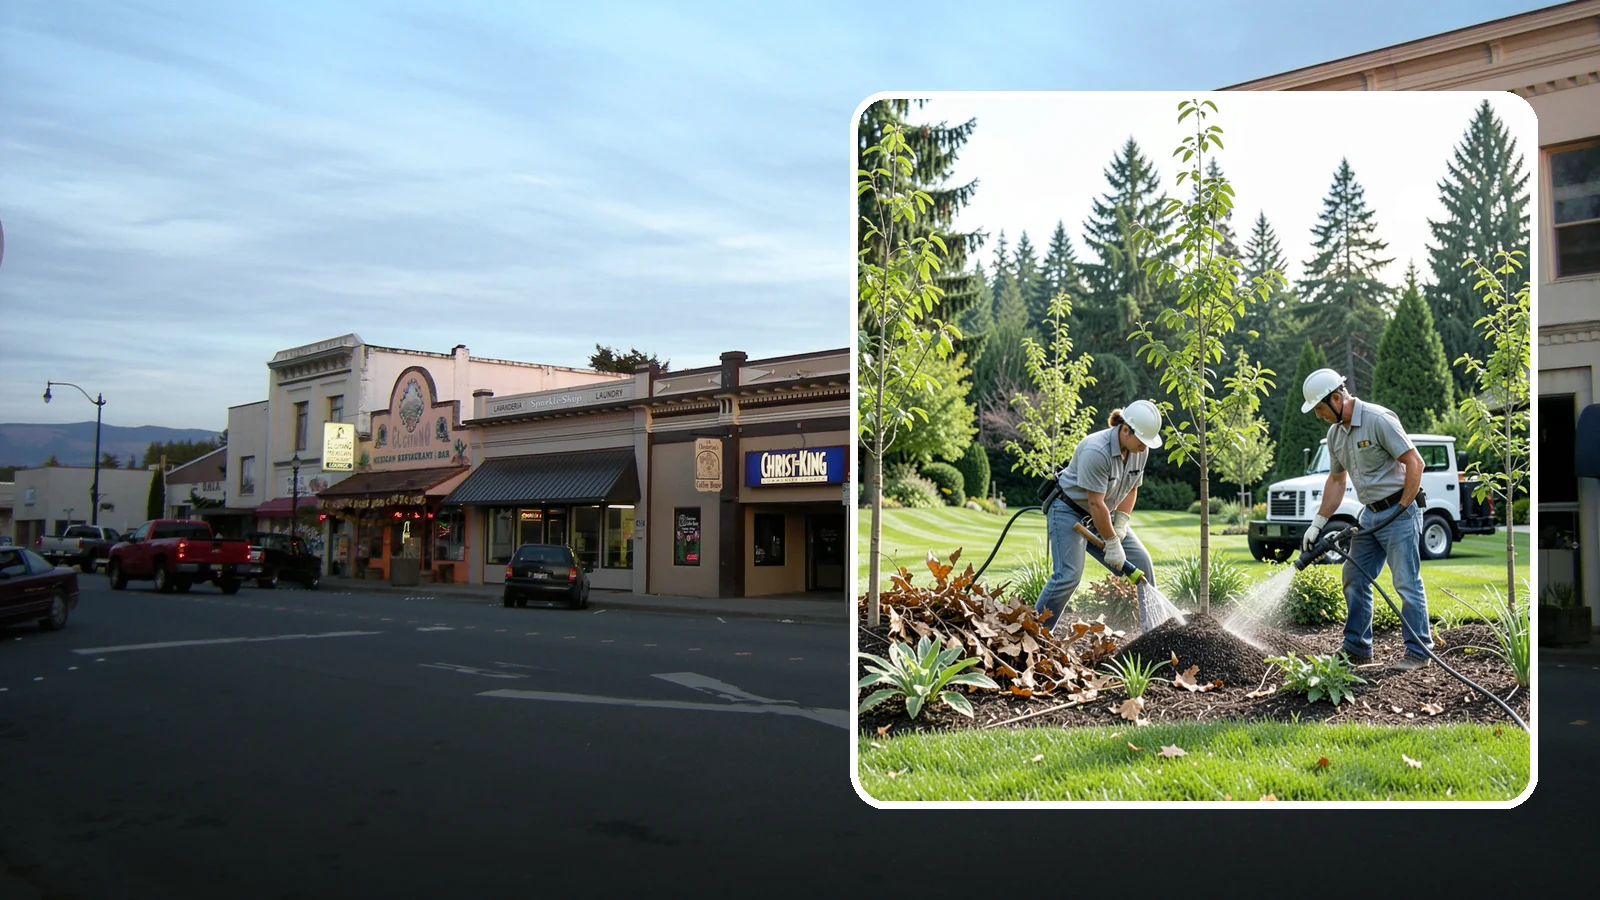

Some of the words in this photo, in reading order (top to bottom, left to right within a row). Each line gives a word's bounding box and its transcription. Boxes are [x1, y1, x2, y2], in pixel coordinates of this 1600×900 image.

[595, 389, 624, 400] LAUNDRY
[493, 401, 523, 413] LAVANDERIA
[373, 454, 396, 464] MEXICAN
[397, 451, 433, 462] RESTAURANT
[438, 450, 450, 458] BAR
[761, 452, 797, 477] CHRIST
[799, 450, 827, 476] KING
